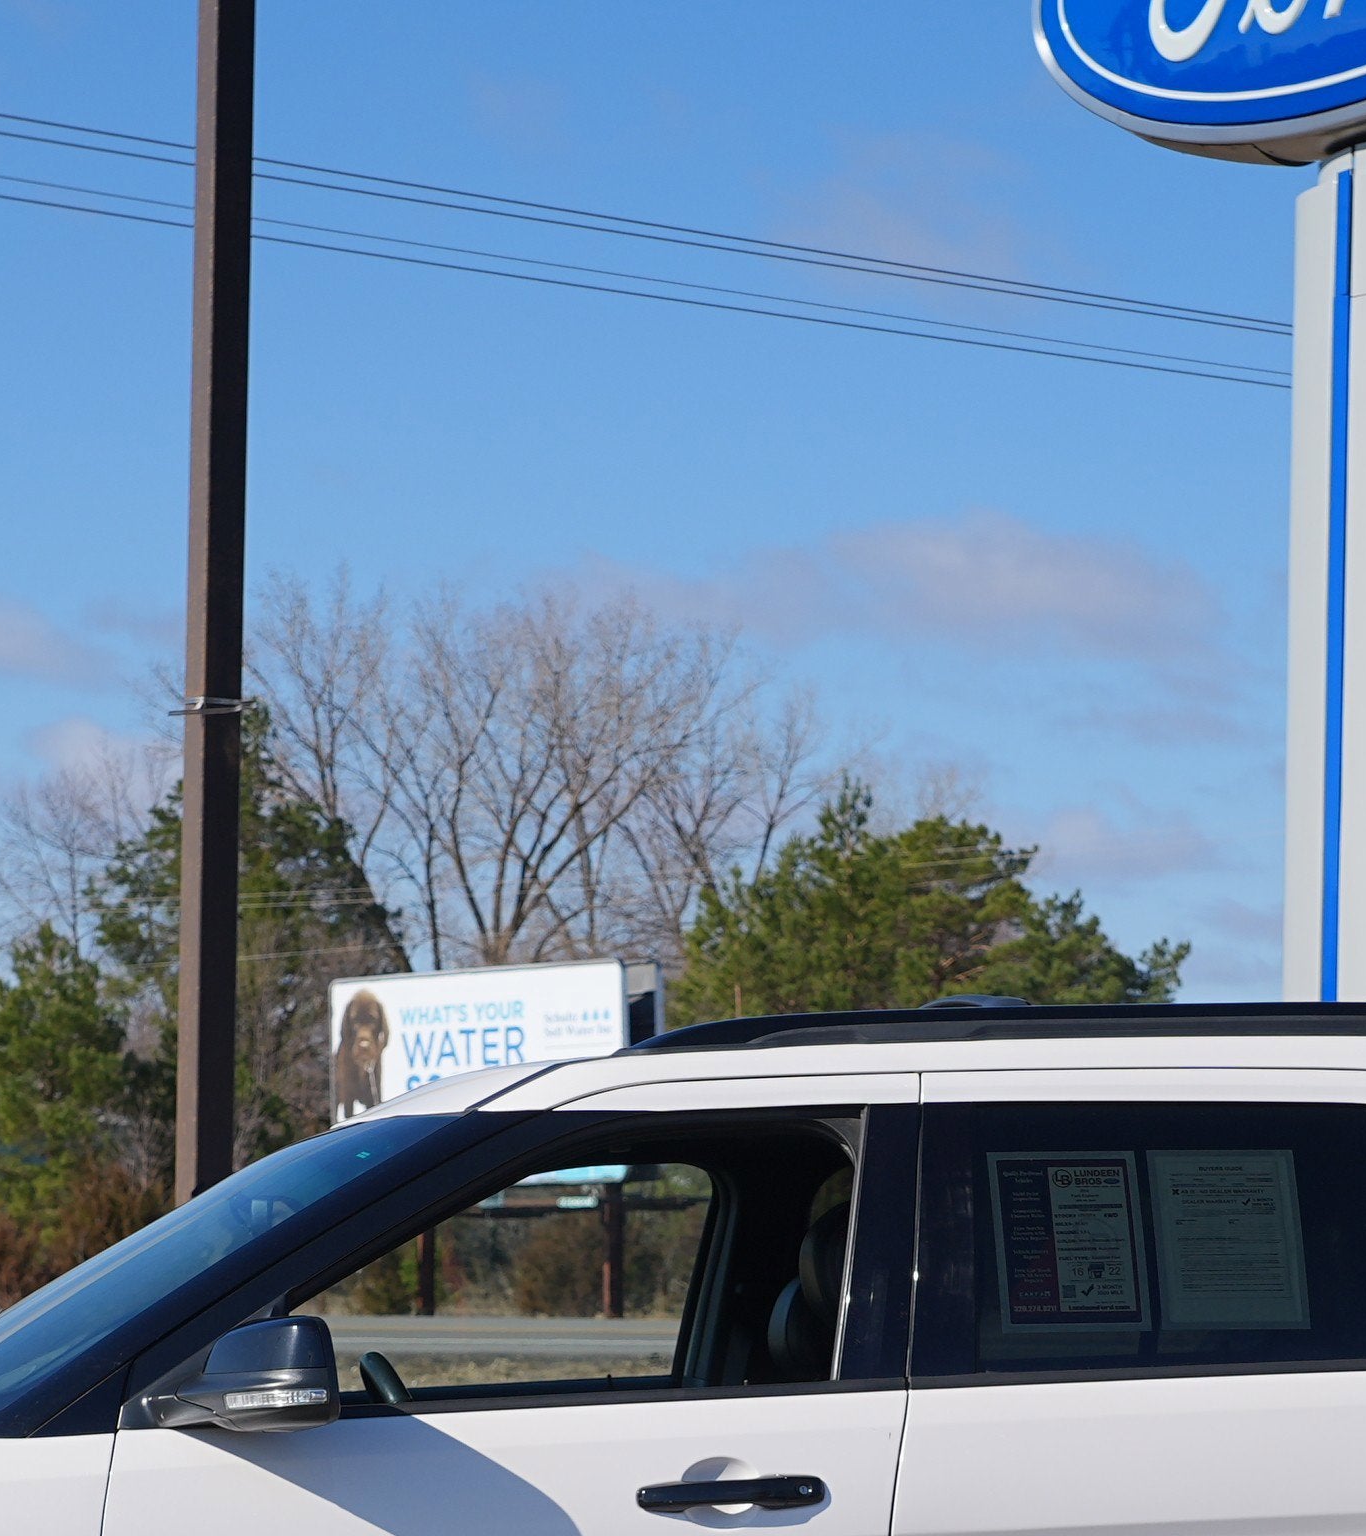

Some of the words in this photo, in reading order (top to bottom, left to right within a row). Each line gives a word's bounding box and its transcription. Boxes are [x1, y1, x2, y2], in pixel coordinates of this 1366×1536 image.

[400, 1004, 469, 1026] WHAT'S
[474, 1001, 525, 1020] YOUR
[401, 1026, 526, 1068] WATER
[1073, 1169, 1121, 1177] LUNDEEN
[1074, 1177, 1103, 1186] BROS
[1071, 1267, 1084, 1277] 16
[1108, 1267, 1121, 1276] 22
